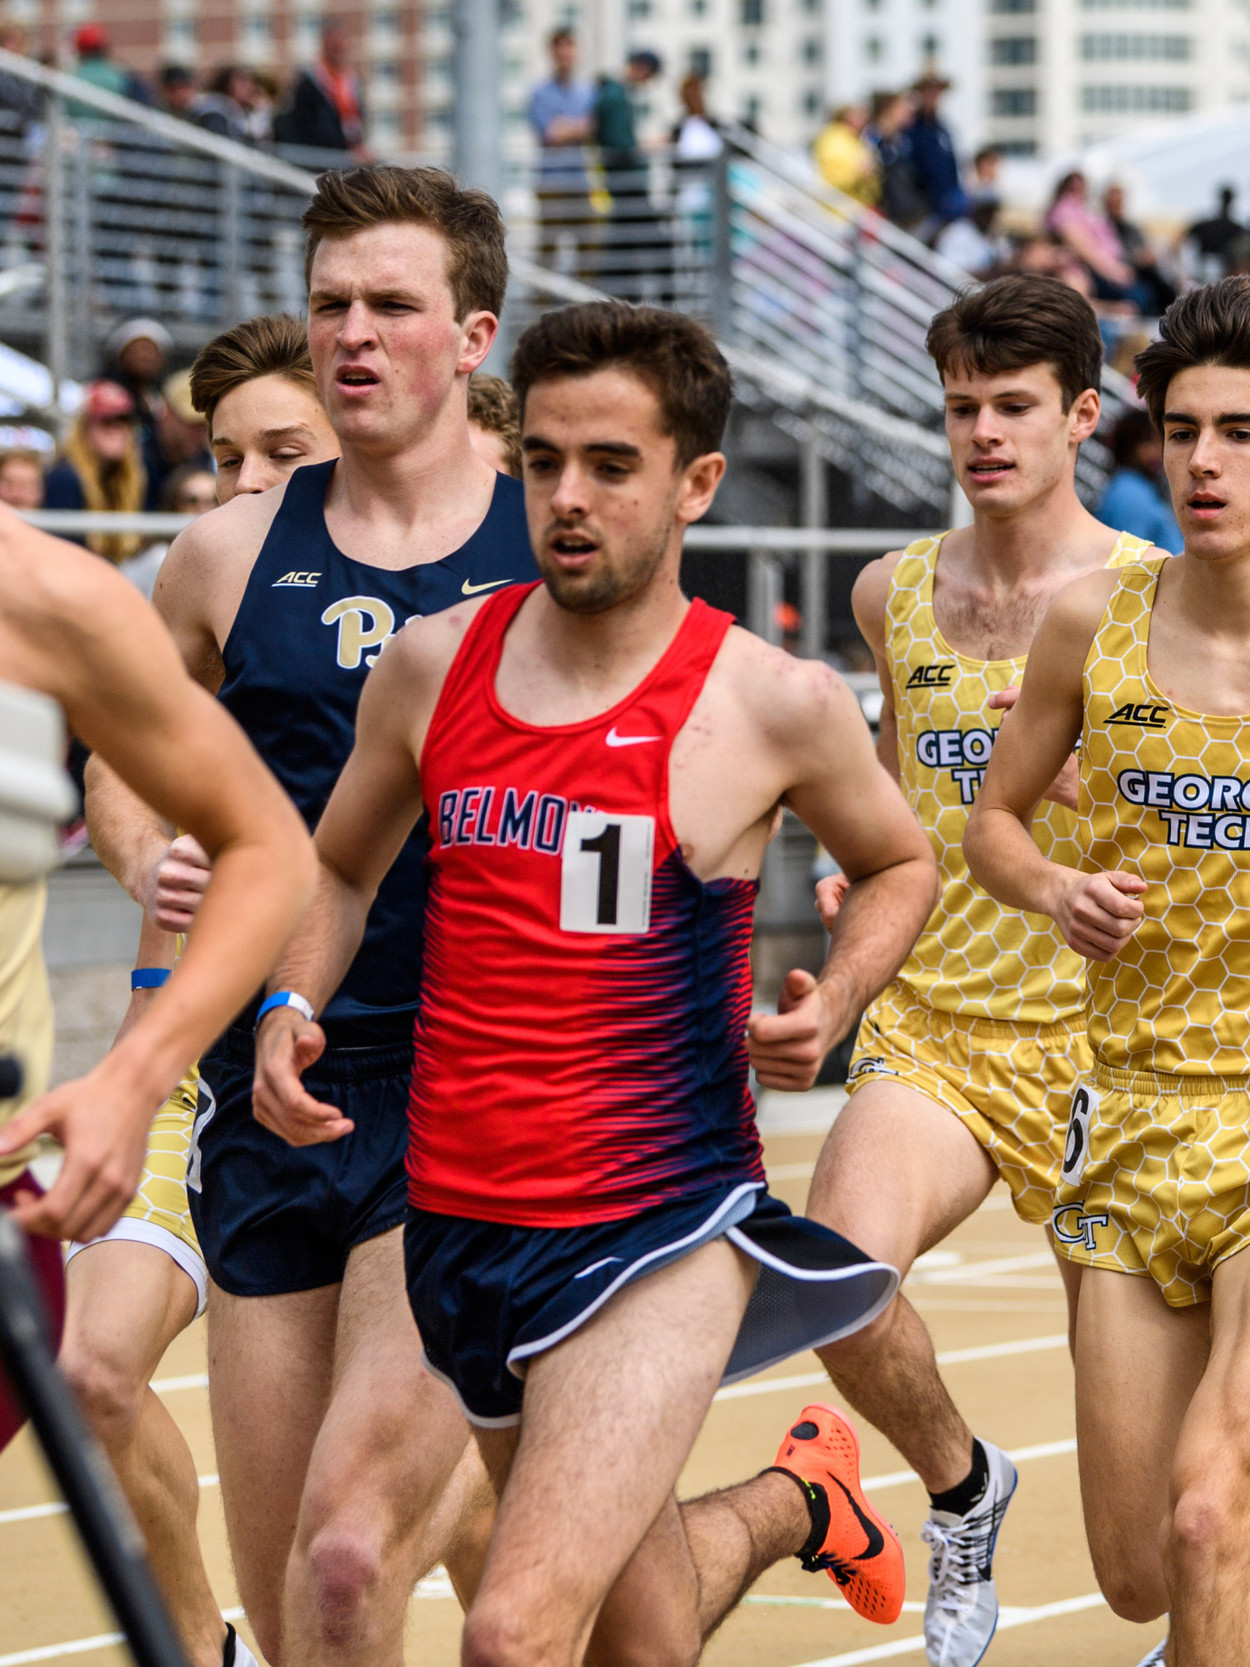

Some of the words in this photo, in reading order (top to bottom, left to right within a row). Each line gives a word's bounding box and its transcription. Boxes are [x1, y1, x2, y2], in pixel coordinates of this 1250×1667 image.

[272, 571, 322, 587] ACC
[906, 665, 955, 689] ACC
[1103, 703, 1169, 728] ACC
[916, 728, 1000, 768] GEO
[439, 786, 598, 855] BELMO
[580, 824, 622, 925] 1
[1063, 1088, 1090, 1173] 6
